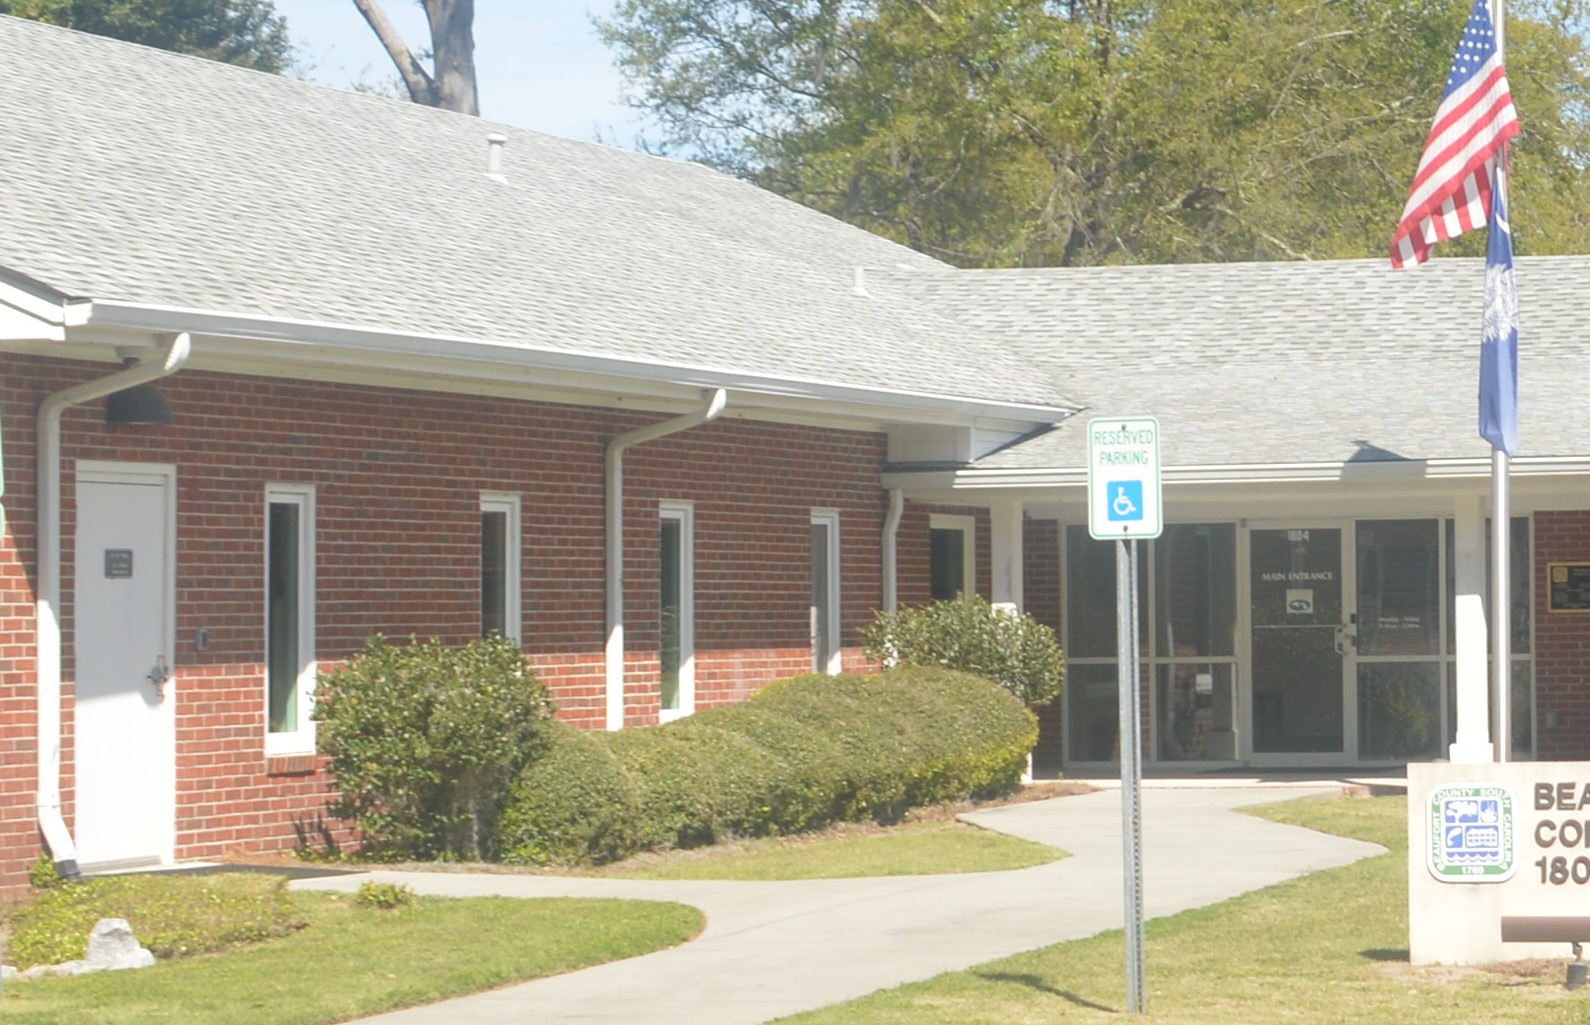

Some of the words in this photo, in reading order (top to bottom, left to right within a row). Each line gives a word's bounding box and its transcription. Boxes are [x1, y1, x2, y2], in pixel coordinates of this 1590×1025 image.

[1094, 429, 1153, 445] RESERVED
[1099, 450, 1149, 465] PARKING
[1261, 572, 1286, 581] MAIN
[1288, 571, 1333, 581] ENTRANCE
[1433, 788, 1473, 804] COUNTY
[1480, 788, 1511, 807] SOUTH
[1432, 812, 1446, 871] BEAUFORT
[1499, 813, 1513, 870] CAROLINA
